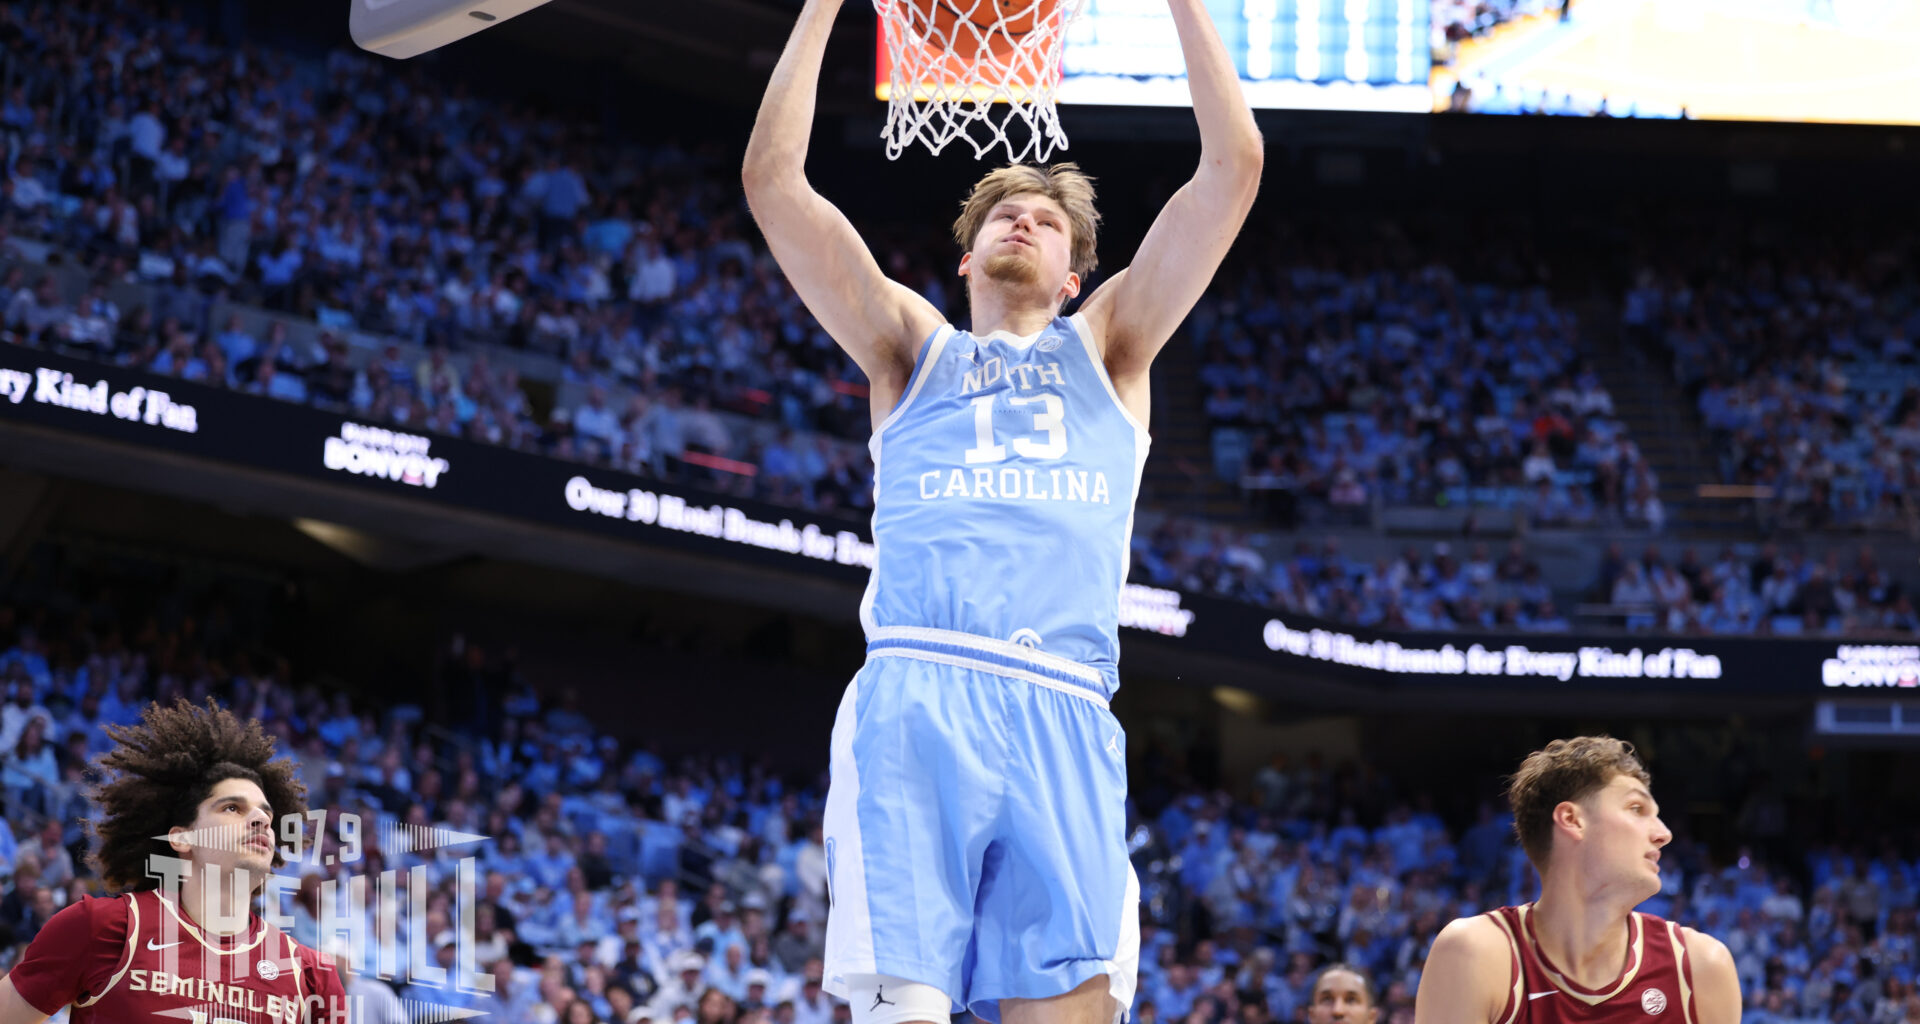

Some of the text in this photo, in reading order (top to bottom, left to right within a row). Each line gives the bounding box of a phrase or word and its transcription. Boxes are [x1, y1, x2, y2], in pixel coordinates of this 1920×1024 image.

[35, 367, 109, 414] Kind
[111, 387, 146, 421] of
[959, 357, 1066, 396] NOTH
[965, 393, 1068, 465] 13
[919, 468, 1110, 505] CAROLINA
[129, 969, 299, 1024] SEMINOLES
